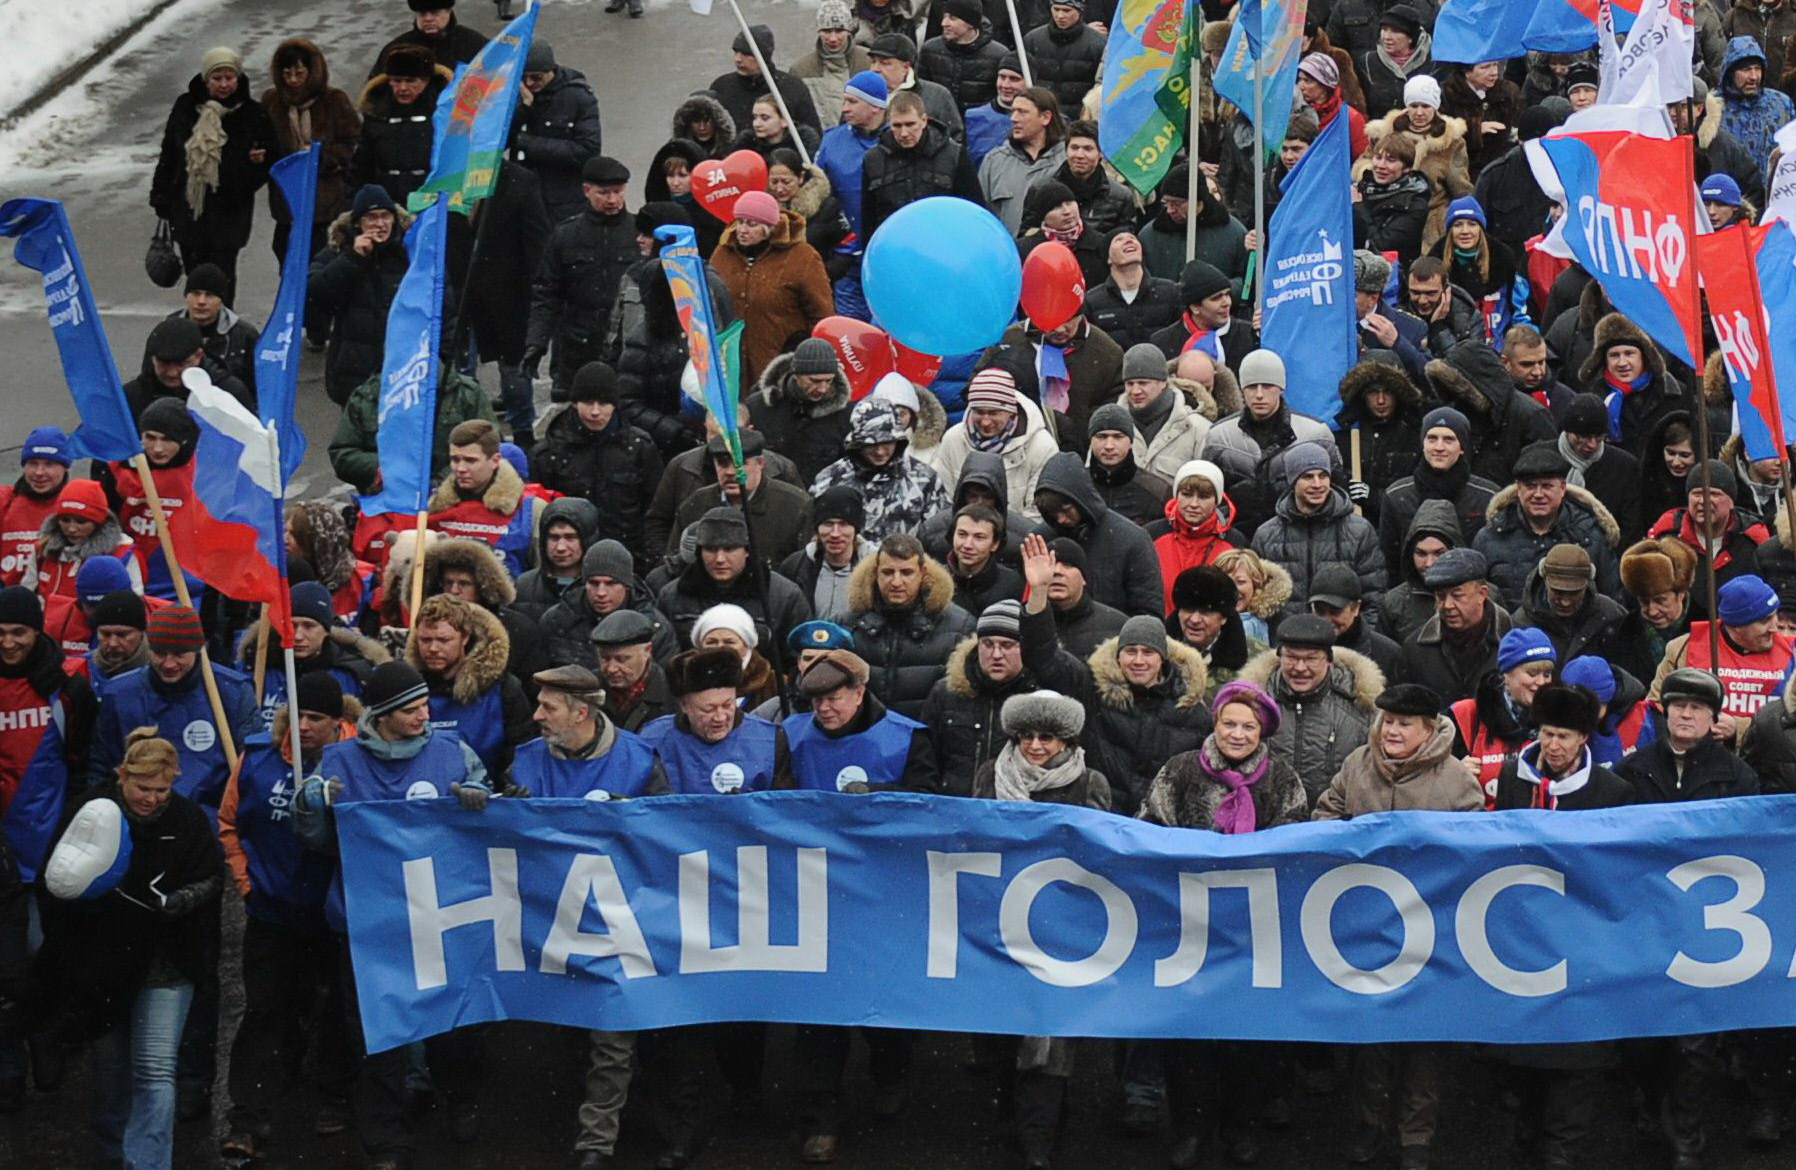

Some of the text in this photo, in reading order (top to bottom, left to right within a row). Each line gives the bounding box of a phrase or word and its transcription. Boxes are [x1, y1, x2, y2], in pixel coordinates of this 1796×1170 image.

[1728, 681, 1764, 693] СОВЕТ
[0, 706, 52, 732] НПР
[402, 845, 828, 990] НАШ
[927, 849, 1568, 997] ГОЛОС
